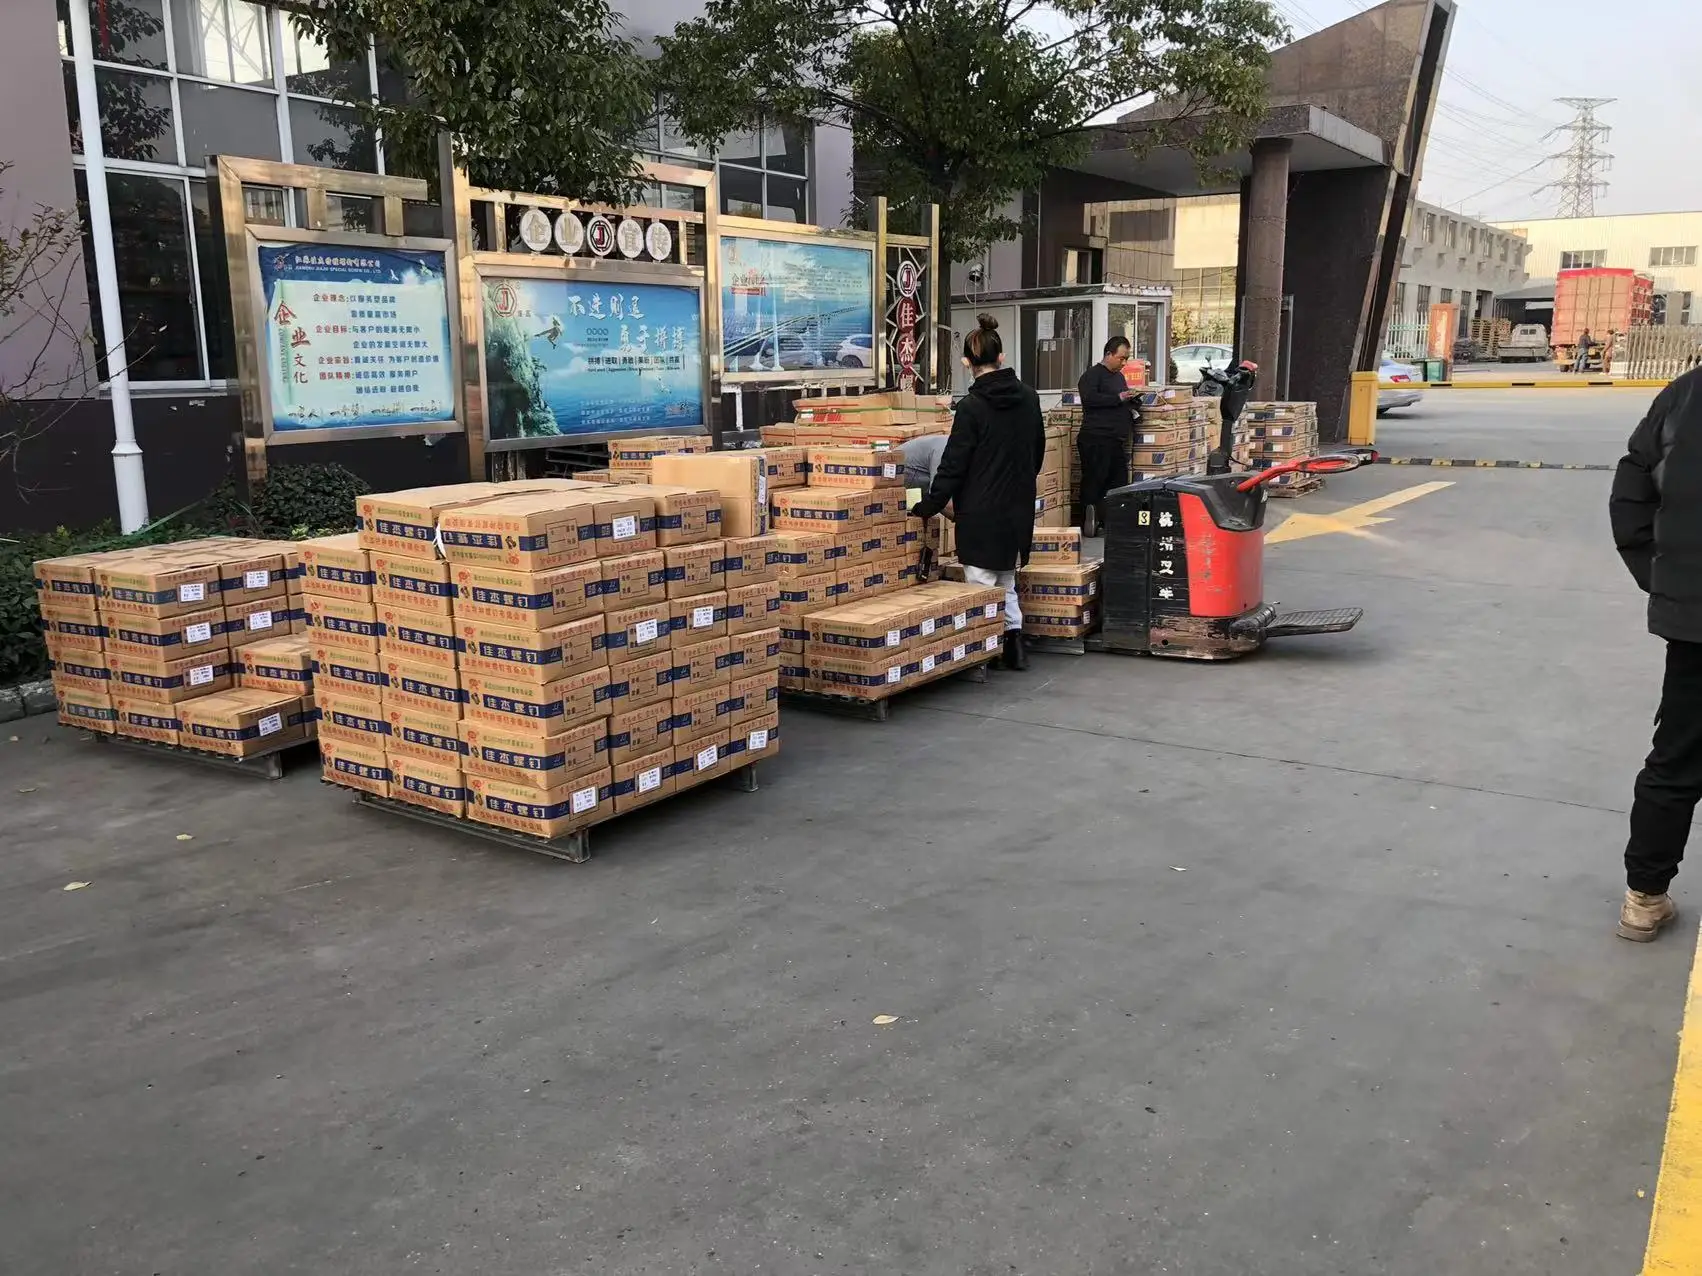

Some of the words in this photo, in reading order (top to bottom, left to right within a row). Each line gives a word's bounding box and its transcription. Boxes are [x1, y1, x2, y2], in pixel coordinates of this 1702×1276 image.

[274, 300, 311, 384] 企业文化
[379, 521, 428, 539] 佳杰螺钉
[320, 567, 364, 583] 佳杰螺钉
[392, 576, 440, 594] 佳杰螺钉
[476, 589, 528, 607] 佳杰螺钉
[326, 618, 371, 635] 佳杰螺钉
[401, 629, 450, 648] 佳杰螺钉
[483, 645, 538, 663] 佳杰螺钉
[332, 666, 376, 684] 佳杰螺钉
[405, 680, 456, 701] 佳杰螺钉
[486, 696, 540, 716] 佳杰螺钉
[335, 713, 379, 732] 佳杰螺钉
[406, 730, 457, 750] 佳杰螺钉
[485, 749, 541, 769] 佳杰螺钉
[337, 760, 382, 779] 佳杰螺钉
[406, 778, 457, 799] 佳杰螺钉
[489, 798, 545, 818] 佳杰螺钉
